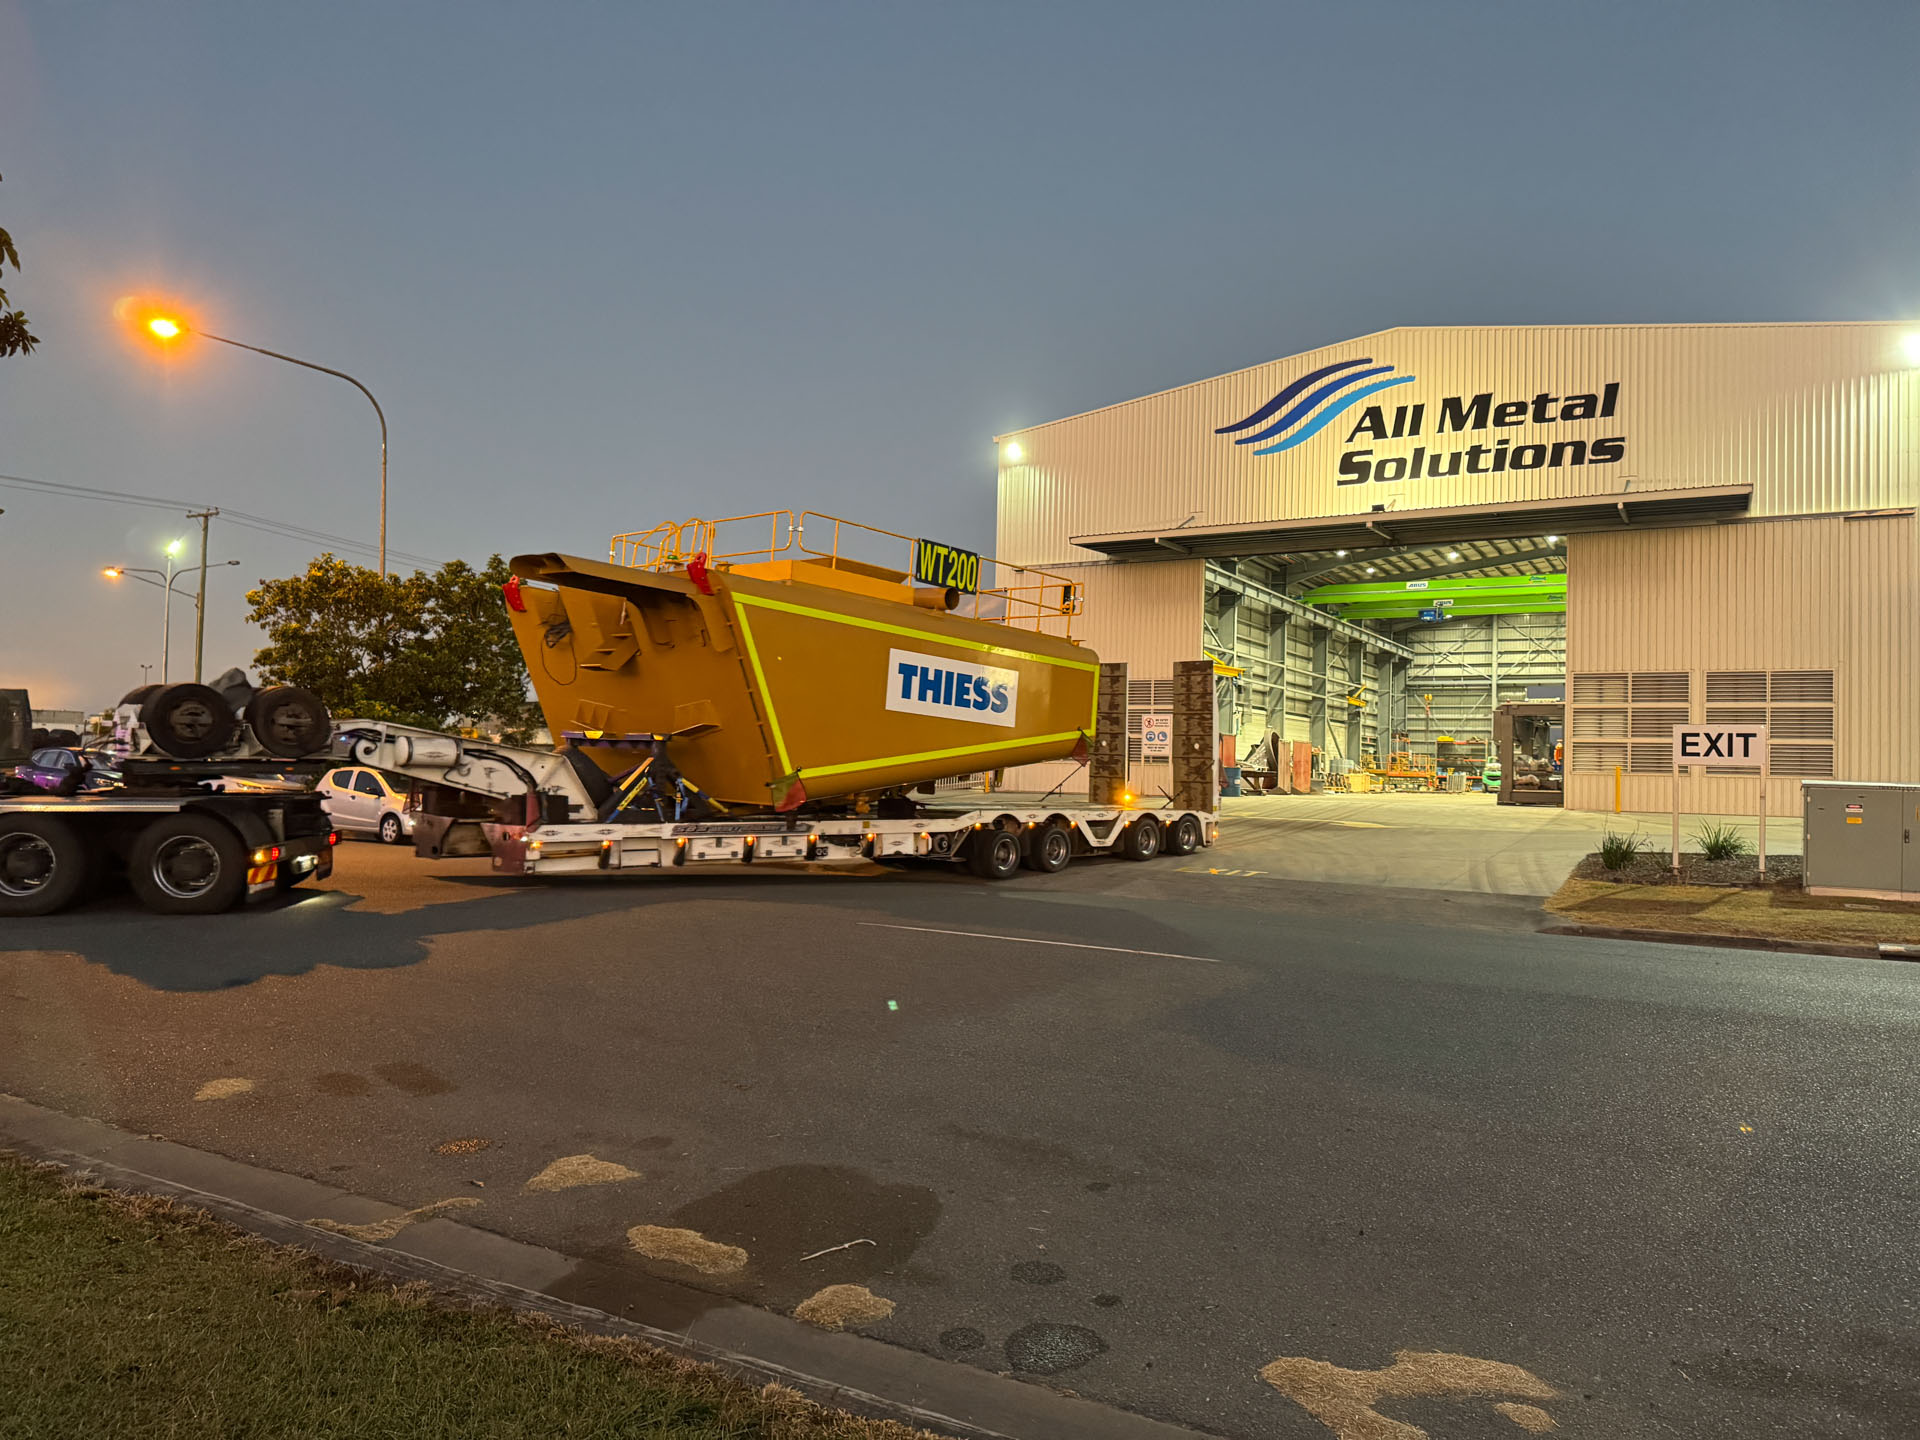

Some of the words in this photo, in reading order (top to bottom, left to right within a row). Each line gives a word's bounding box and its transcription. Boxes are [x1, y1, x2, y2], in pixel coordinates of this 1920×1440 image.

[1345, 404, 1424, 443] All
[1437, 382, 1620, 434] Metal
[1337, 436, 1626, 486] Solutions
[920, 541, 977, 592] WT200
[898, 662, 1009, 713] THIESS
[1681, 732, 1757, 758] EXIT
